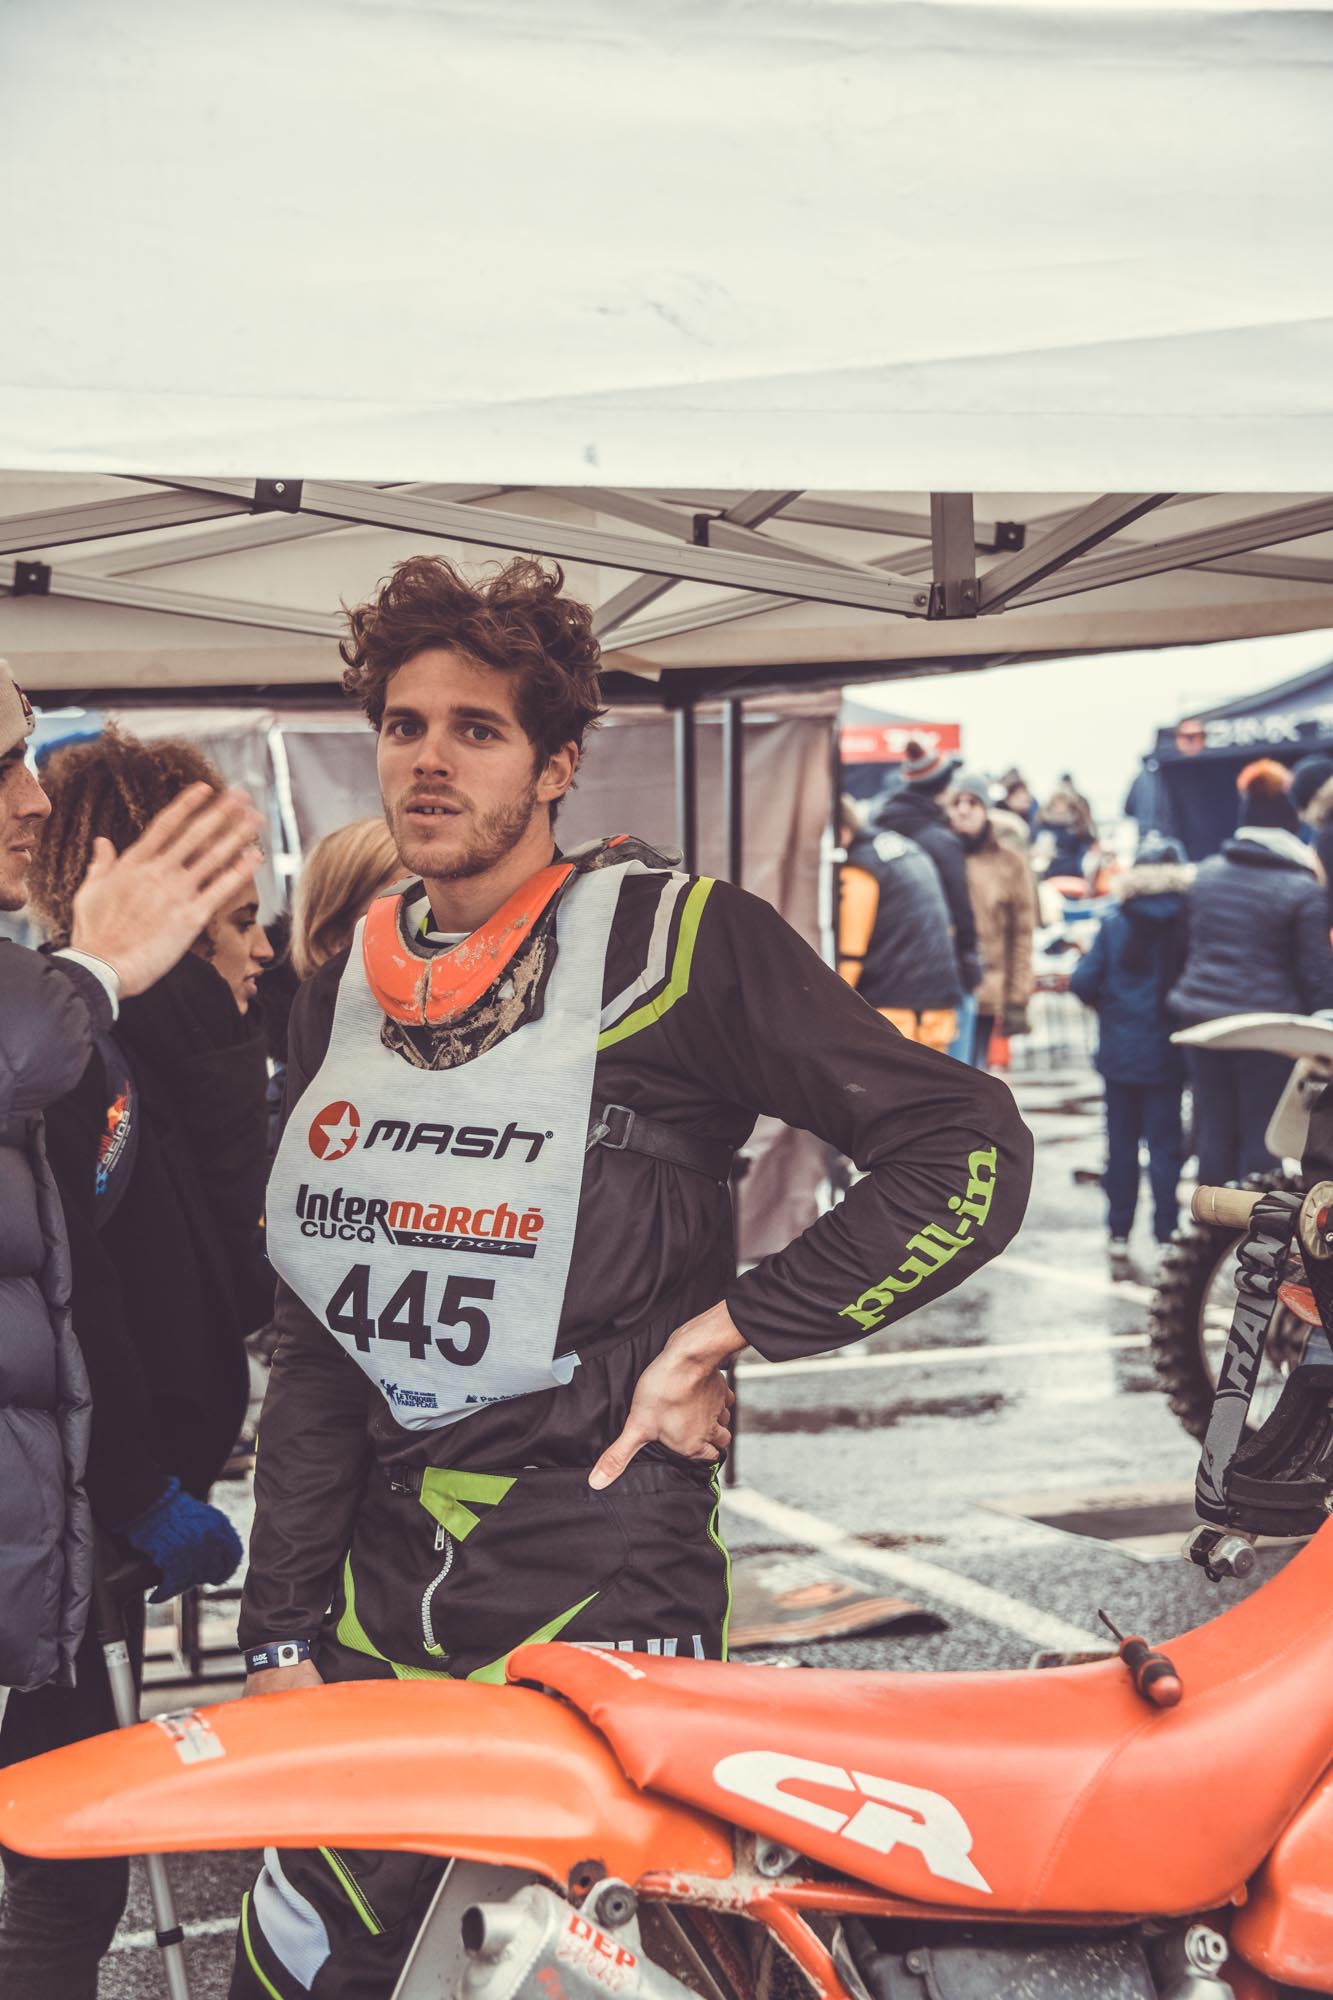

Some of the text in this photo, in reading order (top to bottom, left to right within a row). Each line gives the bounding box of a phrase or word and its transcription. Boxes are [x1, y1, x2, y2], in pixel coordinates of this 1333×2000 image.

[300, 1220, 376, 1244] CUCQ
[411, 1234, 521, 1251] super
[838, 1146, 998, 1331] pull-in
[325, 1263, 496, 1367] 445
[712, 1750, 993, 1894] CR
[568, 1914, 637, 1968] DEP
